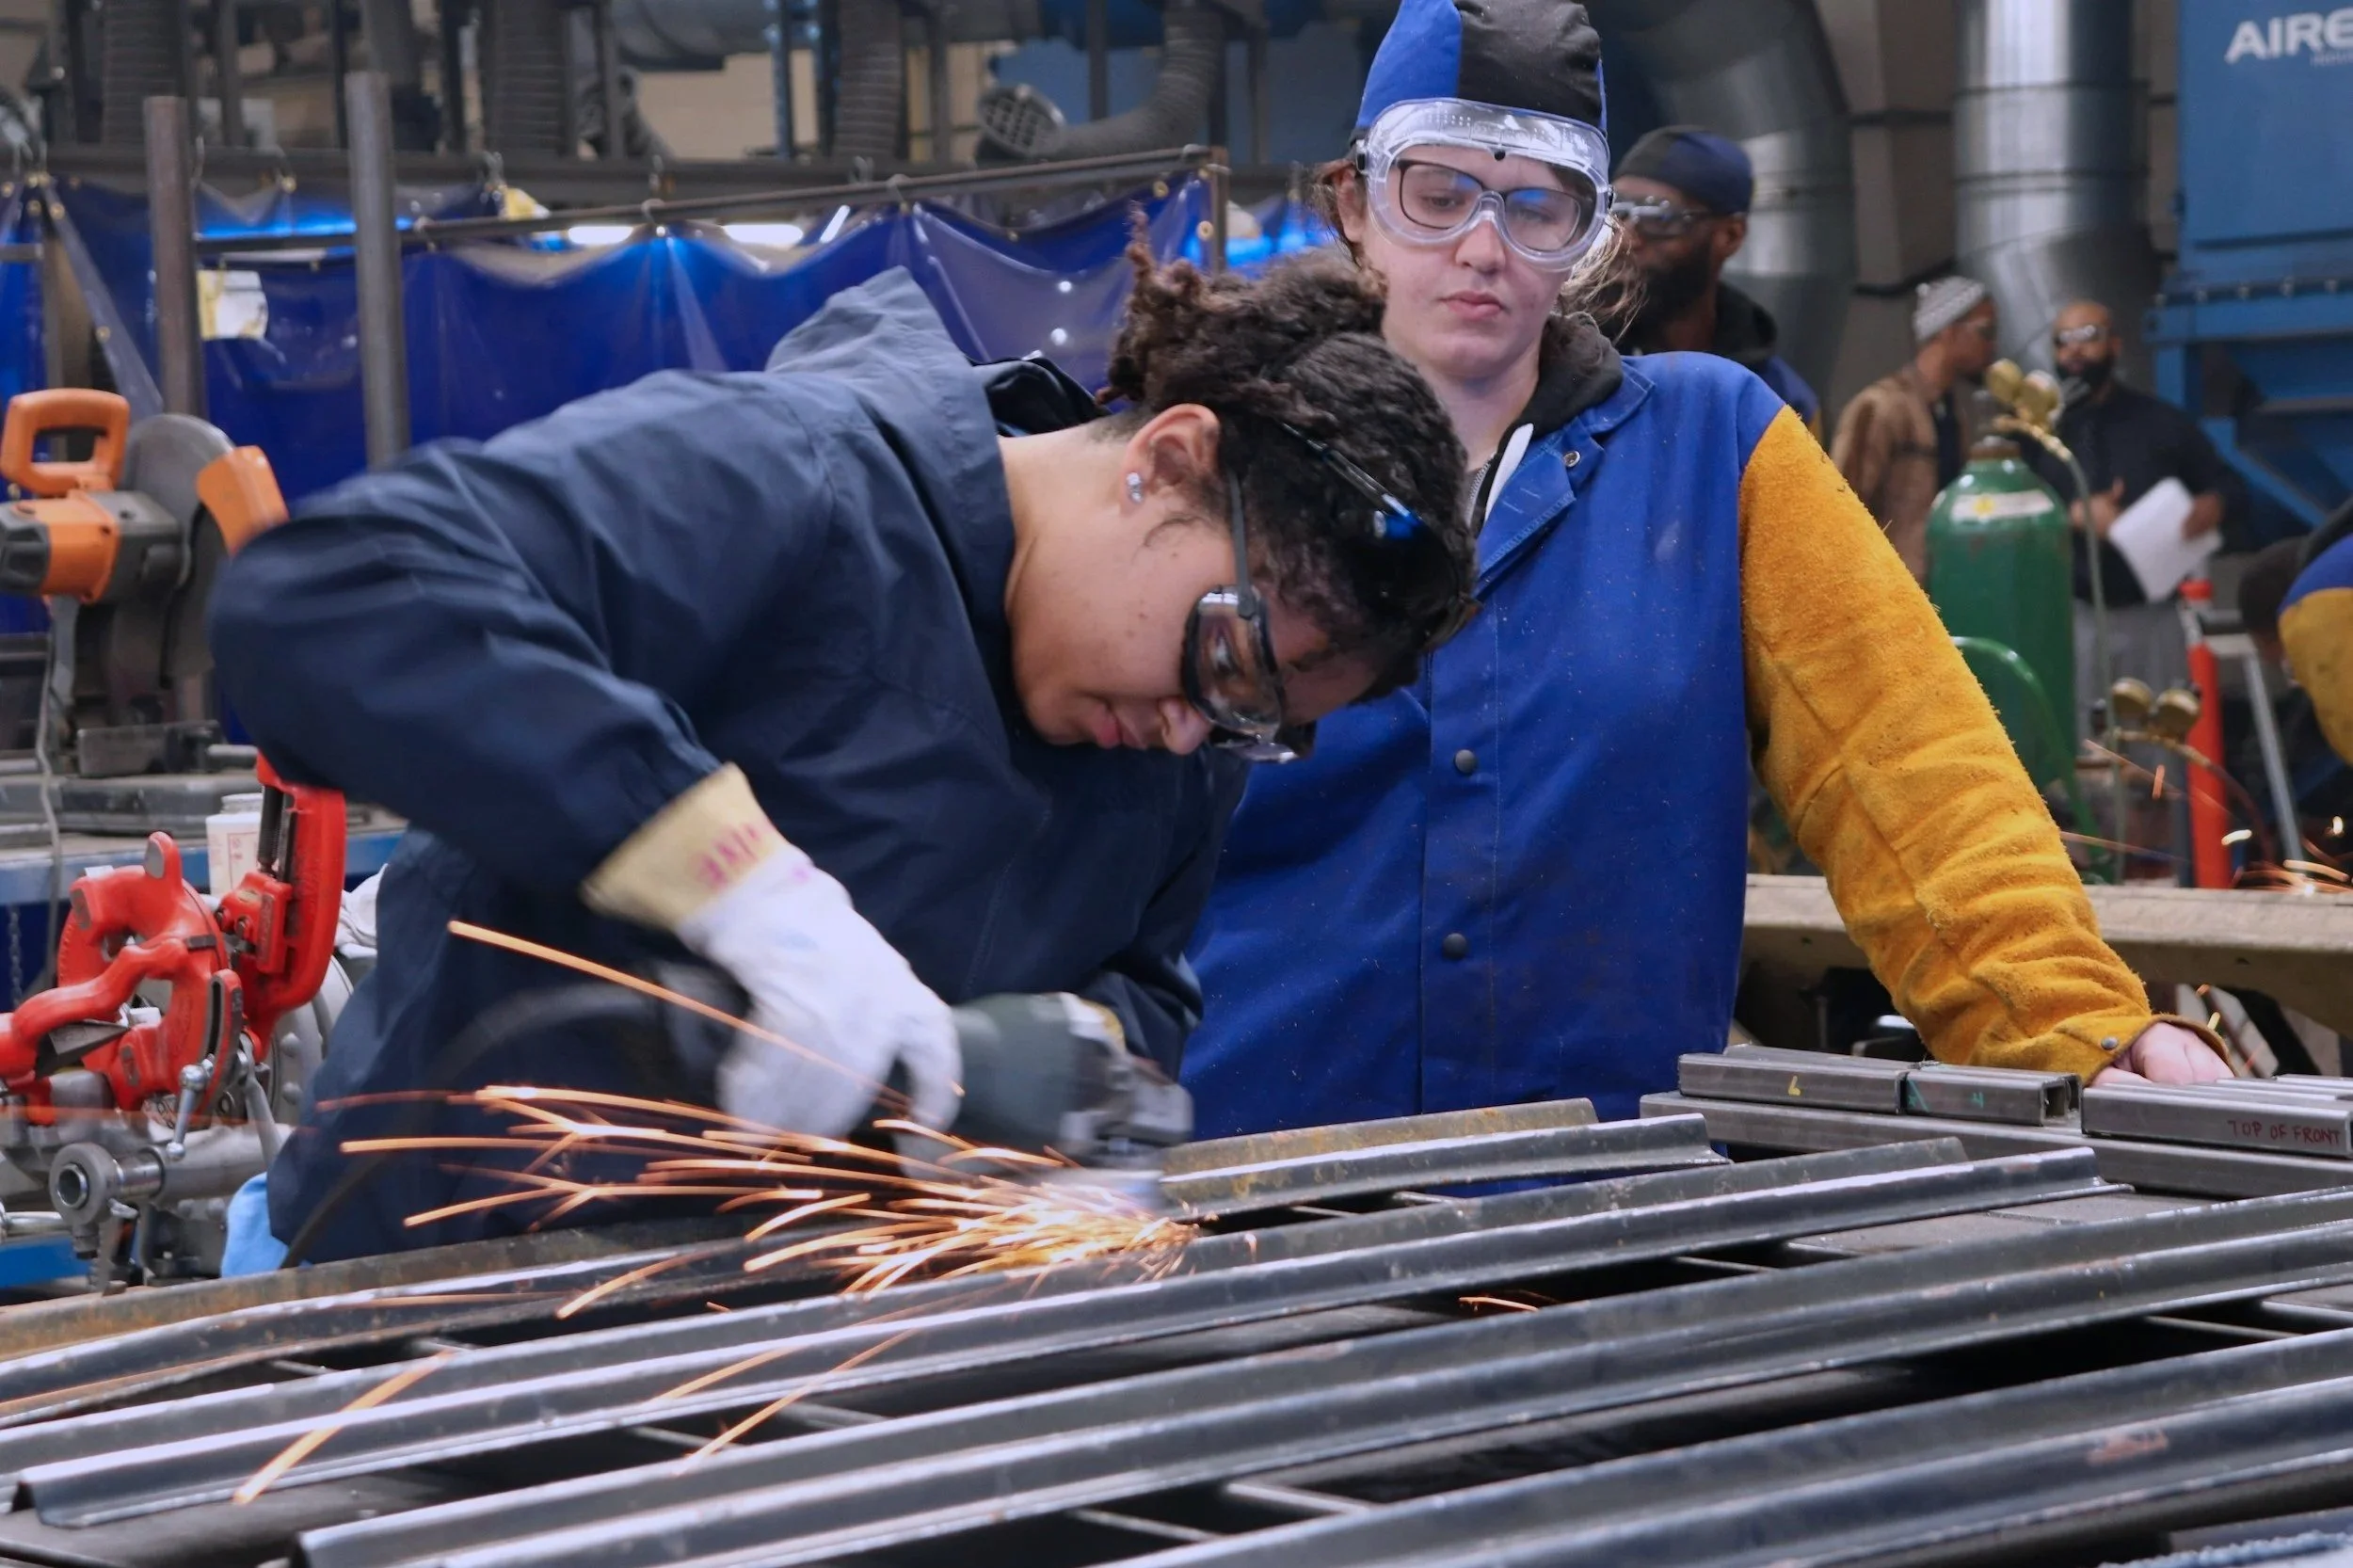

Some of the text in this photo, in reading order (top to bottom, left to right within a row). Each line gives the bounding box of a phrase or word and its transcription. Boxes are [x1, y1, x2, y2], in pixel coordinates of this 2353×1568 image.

[2227, 1119, 2342, 1144] TOP OF FRONT
